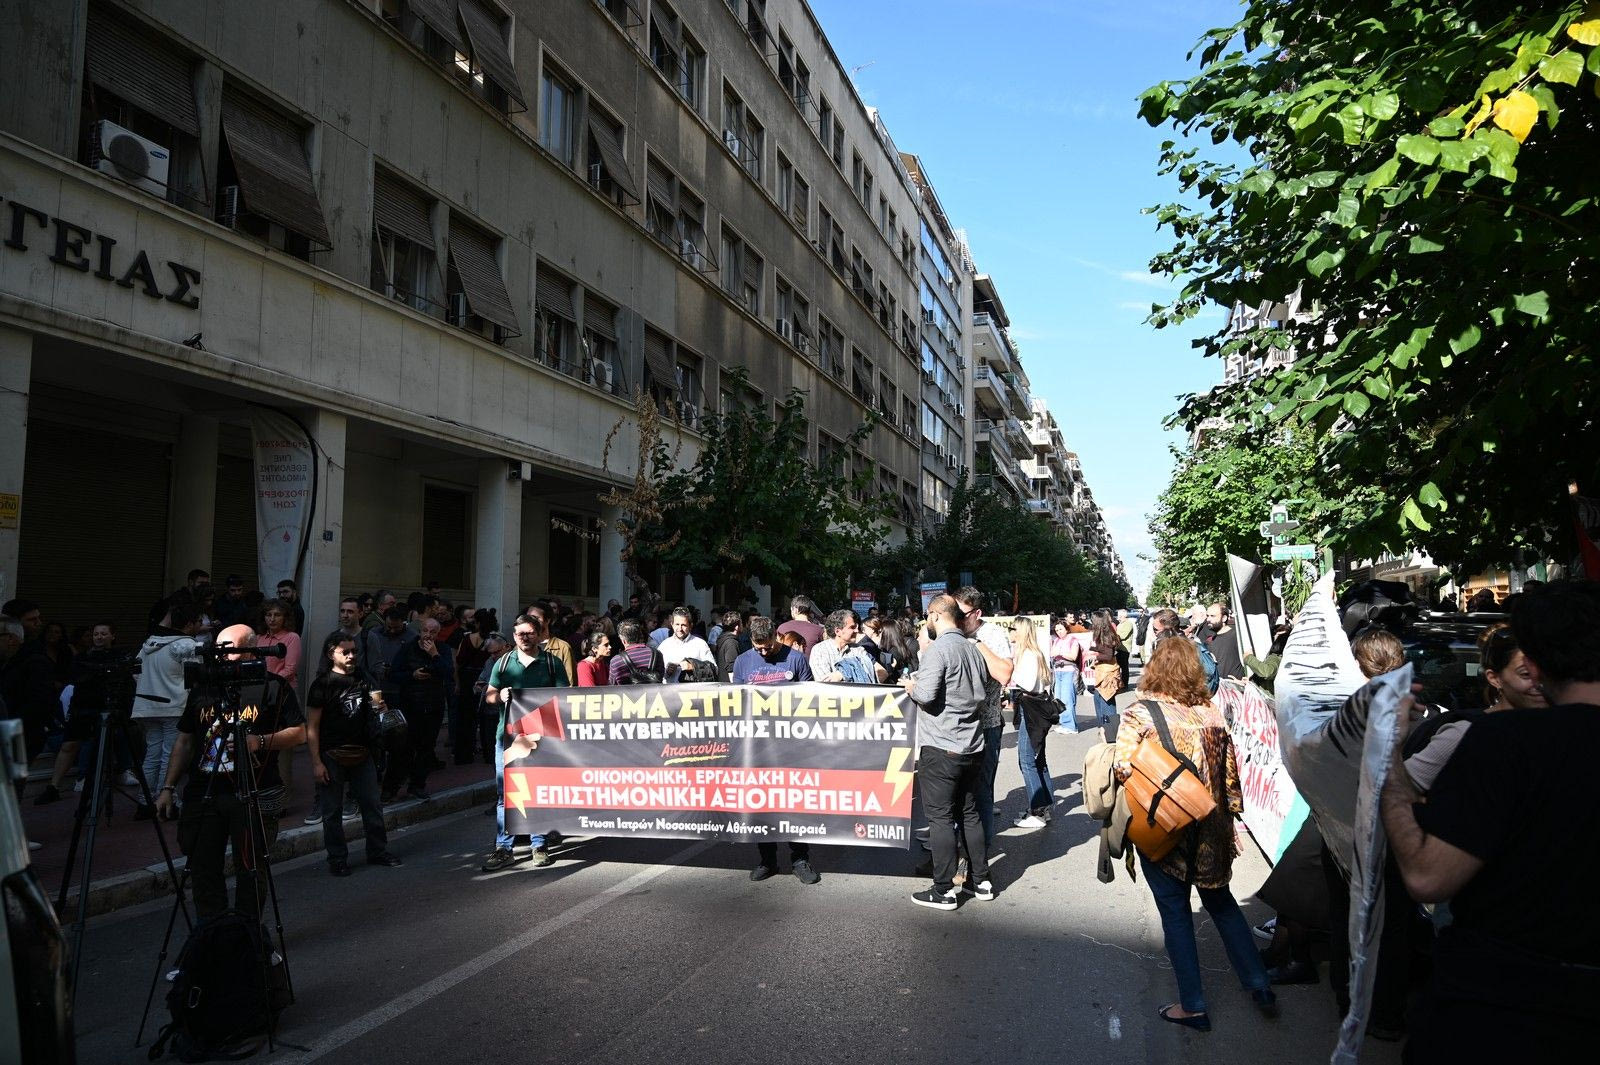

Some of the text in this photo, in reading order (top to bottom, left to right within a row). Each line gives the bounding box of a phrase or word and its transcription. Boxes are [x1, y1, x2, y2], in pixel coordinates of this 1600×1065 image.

[0, 196, 201, 309] ΓΕΙΑΣ
[566, 688, 904, 721] ΤΕΡΜΑ ΣΤΗ ΜΙΖΕΡΙΑ
[567, 720, 908, 741] ΤΗΣ ΚΥΒΕΡΝΗΤΙΚΗΣ ΠΟΛΙΤΙΚΗΣ
[660, 740, 730, 758] Απαιτούμε:
[581, 769, 819, 787] ΟΙΚΟΝΟΜΙΚΗ, ΕΡΓΑΣΙΑΚΗ ΚΑΙ
[536, 785, 883, 813] ΕΠΙΣΤΗΜΟΝΙΚΗ ΑΞΙΟΠΡΕΠΕΙΑ
[578, 815, 615, 829] Ένωση
[617, 816, 654, 832] Ιατρών
[656, 817, 725, 834] Νοσοκομείων
[725, 820, 768, 836] Αθήνας
[779, 820, 827, 837] Πειραιά
[867, 823, 905, 841] ΕΙΝΑΠ
